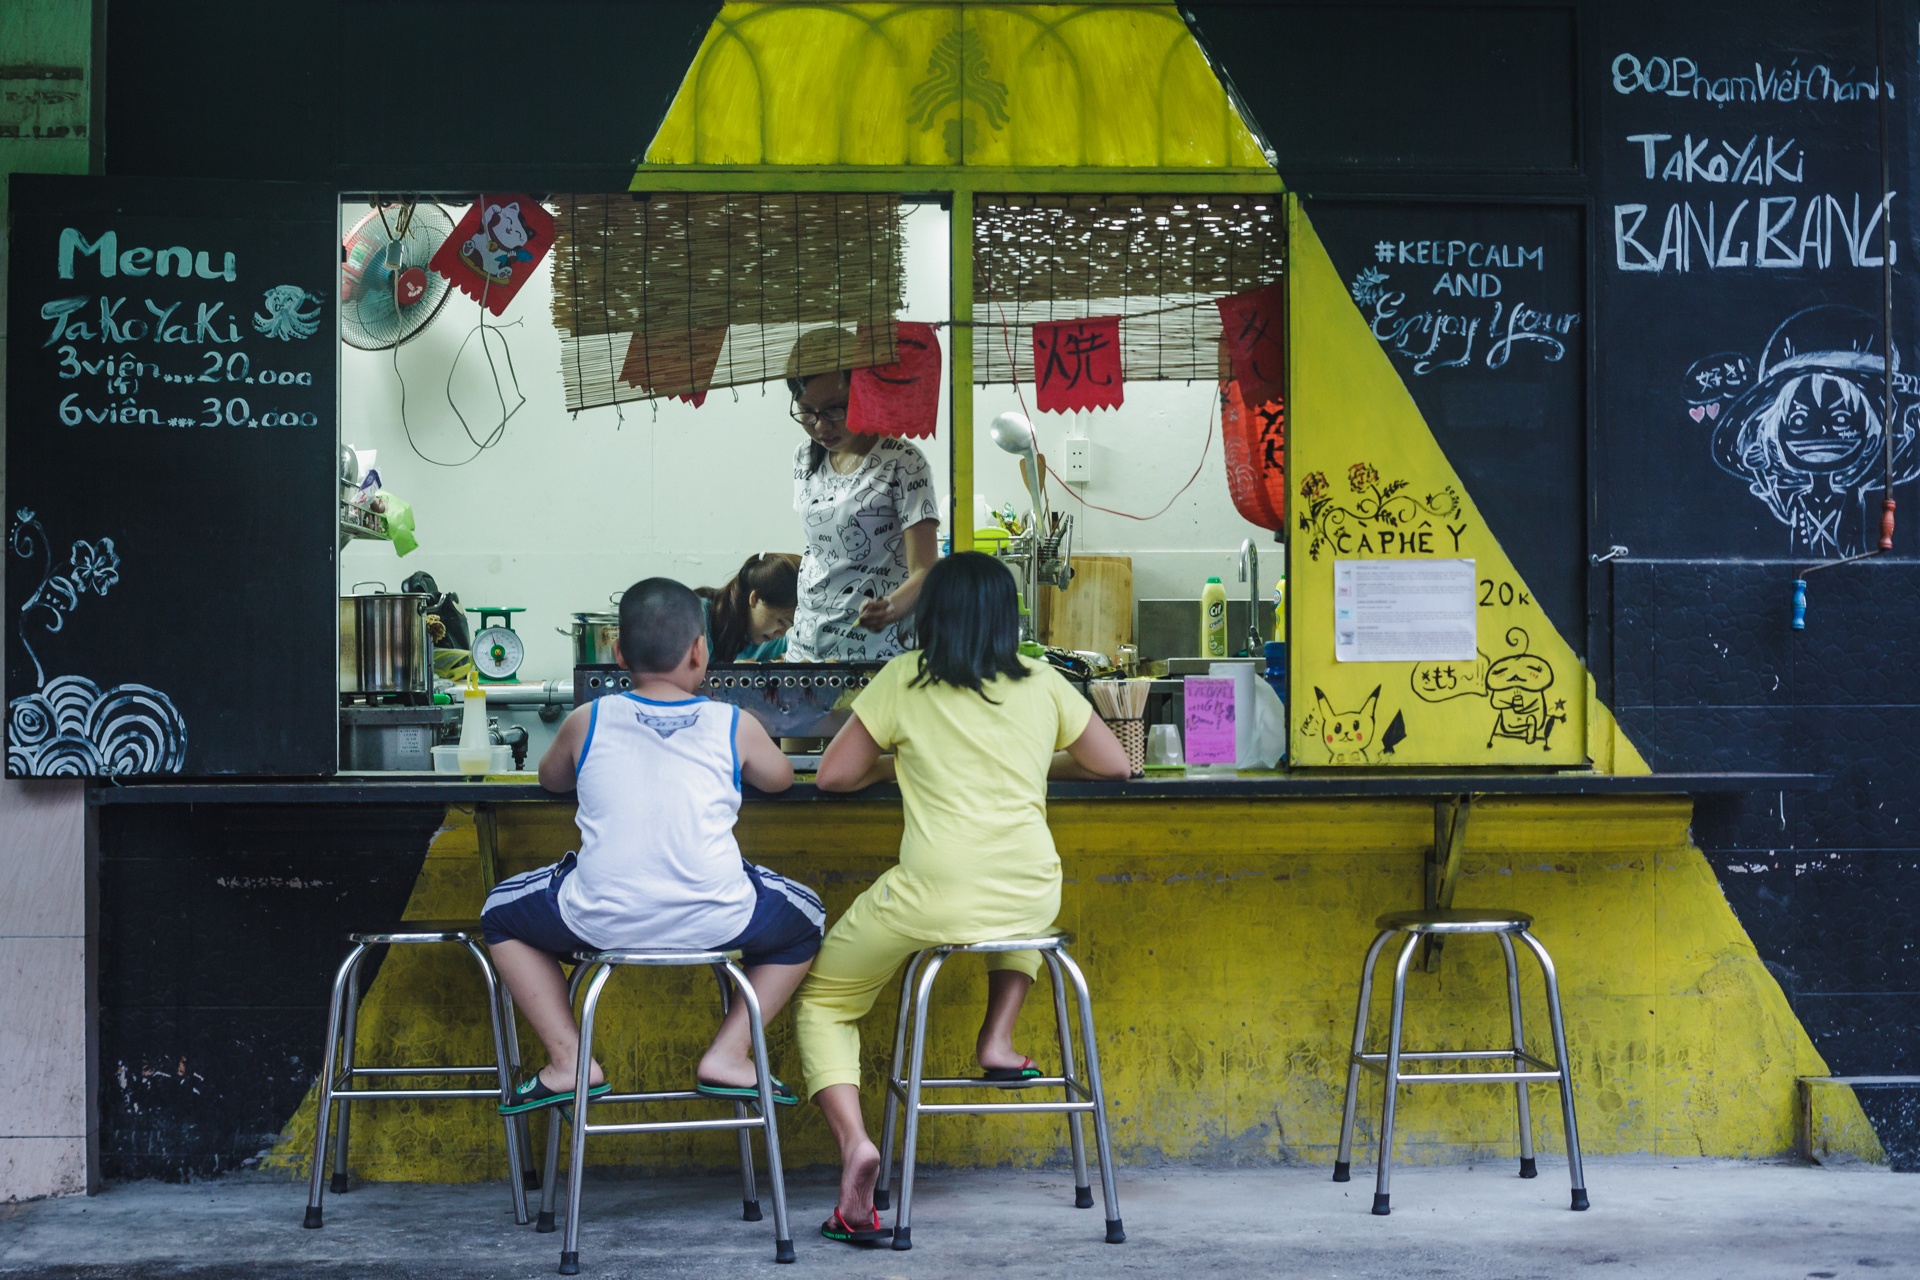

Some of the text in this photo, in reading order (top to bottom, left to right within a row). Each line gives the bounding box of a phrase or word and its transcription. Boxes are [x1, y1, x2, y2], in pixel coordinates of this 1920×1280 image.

[58, 227, 237, 282] Menu
[1432, 272, 1502, 298] AND
[1370, 291, 1581, 376] Enjoy Your
[1209, 602, 1222, 617] Cif
